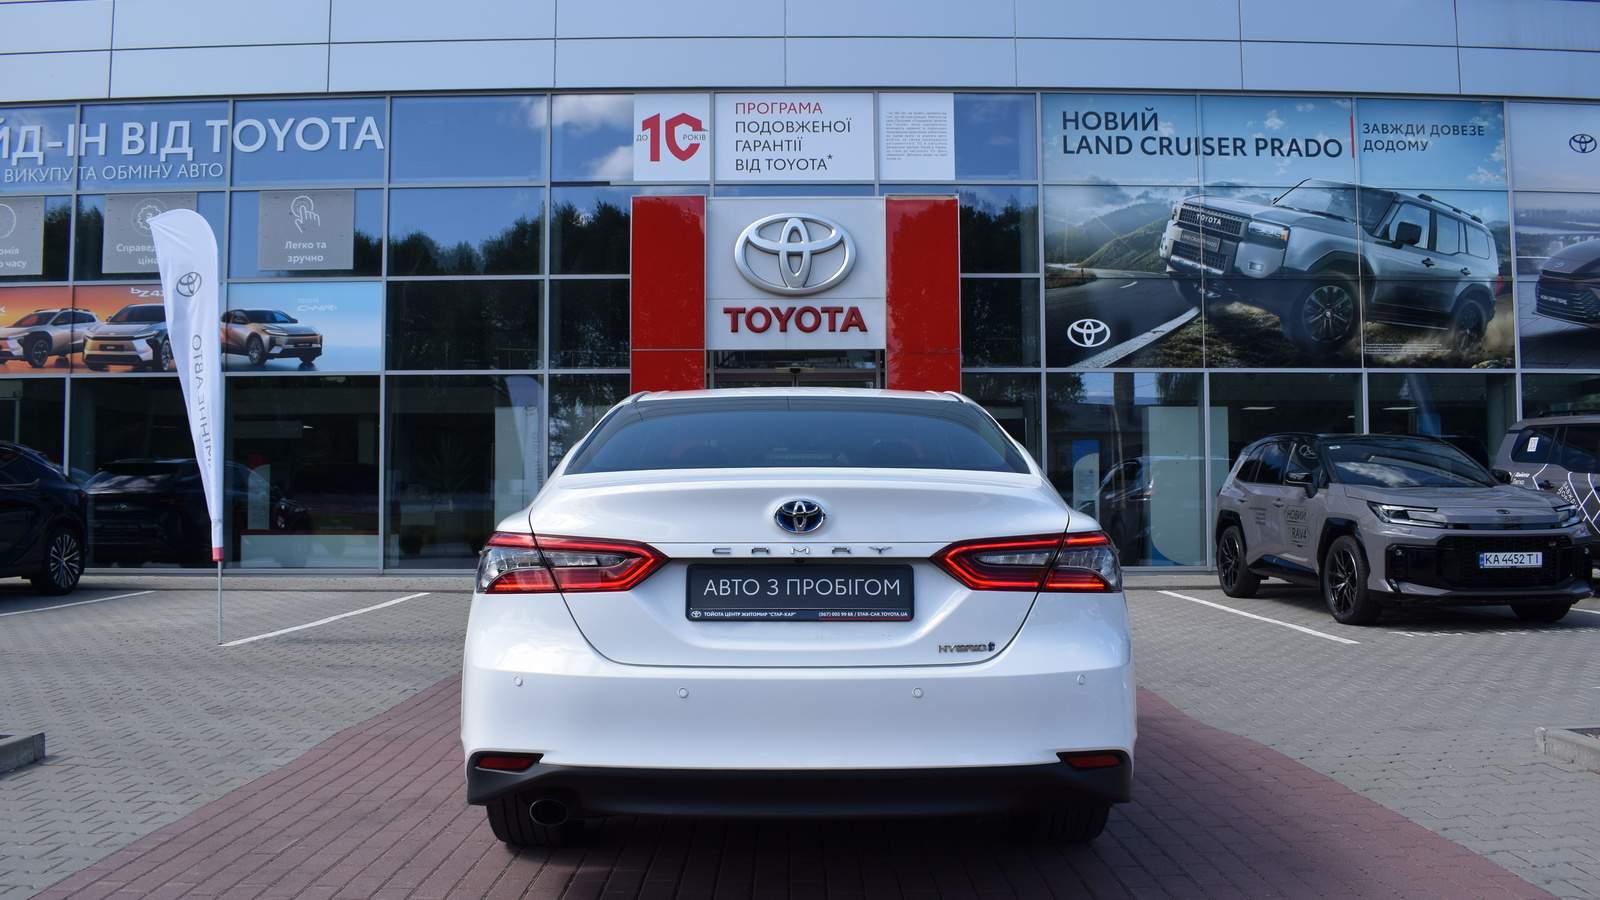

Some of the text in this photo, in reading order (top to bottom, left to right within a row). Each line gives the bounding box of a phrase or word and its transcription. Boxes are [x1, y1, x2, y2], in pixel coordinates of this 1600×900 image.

[735, 102, 823, 115] ПРОГРАМА
[1062, 106, 1159, 132] НОВИЙ
[735, 117, 852, 136] ПОДОВЖЕНОЇ
[1362, 123, 1485, 138] ЗАВЖДИ ДОВЕЗЕ
[121, 121, 194, 162] ВІД
[205, 116, 385, 153] TOYOTA
[636, 134, 649, 142] ДО
[735, 136, 803, 152] ГАРАНТІЇ
[1062, 135, 1343, 158] LAND CRUISER PRADO
[1363, 139, 1429, 153] ДОДОМУ
[5, 163, 224, 183] ВИКУПУ ТА ОБМІНУ АВТО
[735, 158, 761, 174] ВІД
[1196, 213, 1222, 226] TOYOTA
[284, 240, 327, 250] Легко та
[287, 254, 324, 265] зручно
[722, 305, 869, 334] TOYOTA
[1286, 508, 1307, 521] НОВИЙ
[1291, 527, 1308, 541] RAV4
[711, 546, 893, 555] CAMRY
[1485, 554, 1500, 565] KA
[1501, 554, 1525, 565] 4452
[703, 578, 901, 596] АВТО З ПРОБІГОМ
